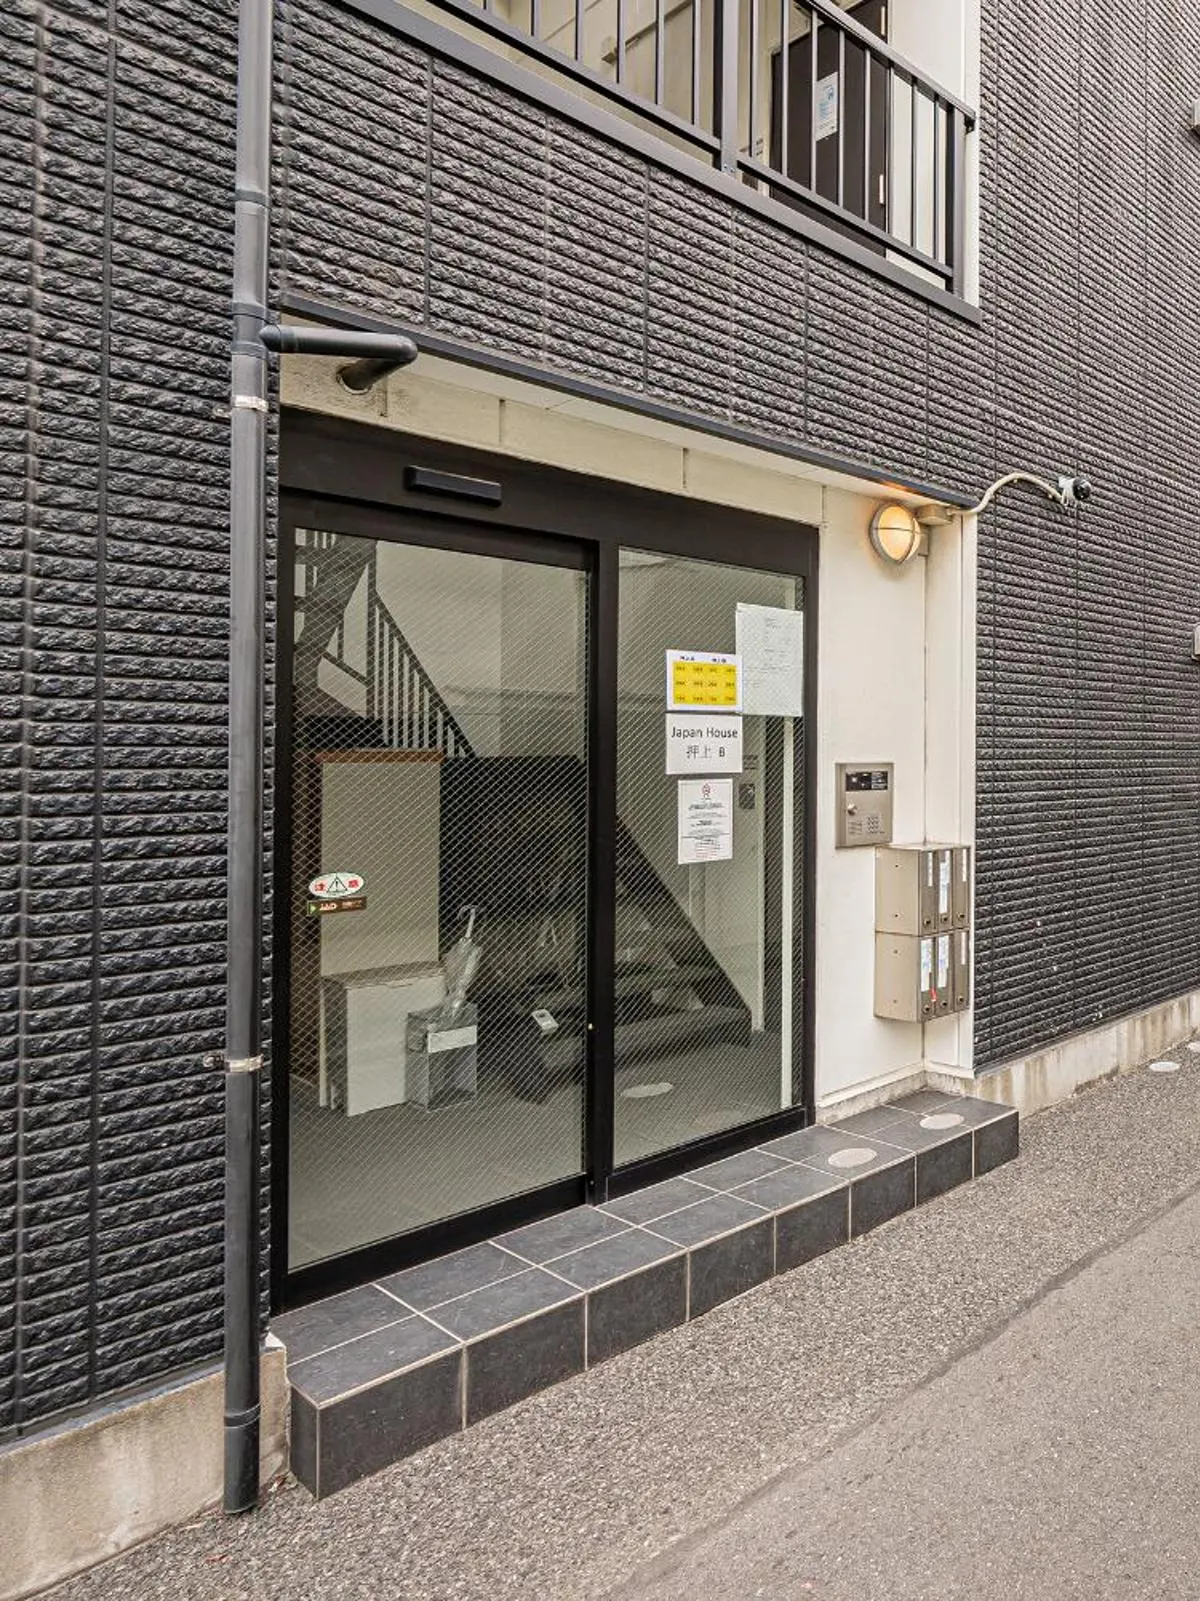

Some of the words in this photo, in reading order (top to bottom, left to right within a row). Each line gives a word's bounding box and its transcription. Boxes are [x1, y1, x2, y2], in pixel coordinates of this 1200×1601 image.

[671, 726, 703, 739] Japan
[706, 727, 738, 738] House
[686, 745, 712, 759] 押上
